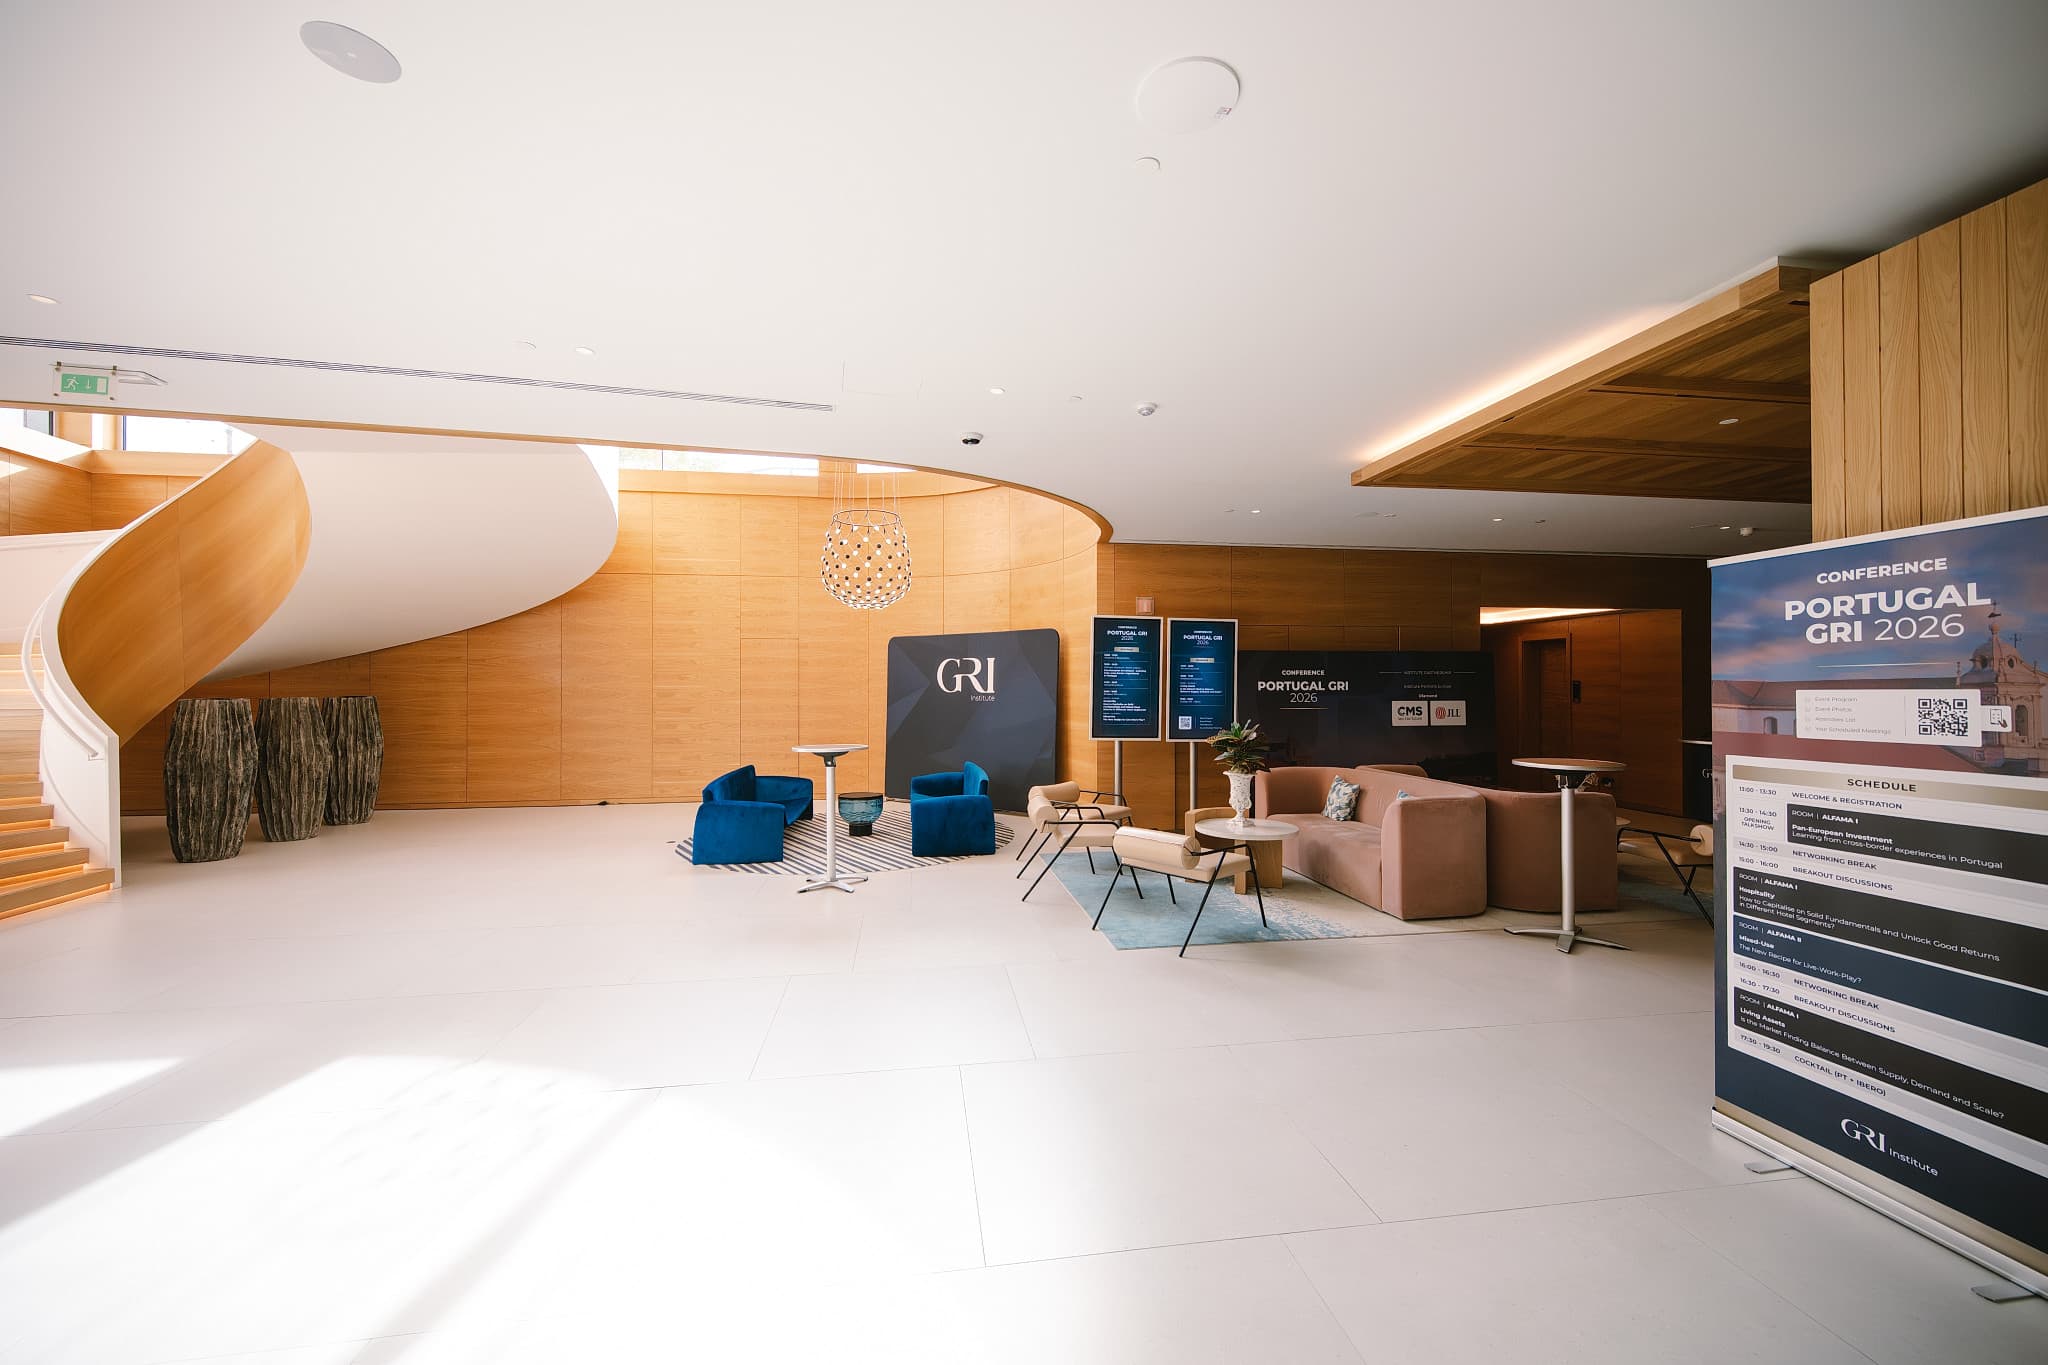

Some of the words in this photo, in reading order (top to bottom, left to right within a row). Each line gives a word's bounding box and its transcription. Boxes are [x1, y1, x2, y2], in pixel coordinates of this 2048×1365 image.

[1817, 558, 1947, 584] CONFERENCE
[1785, 582, 1991, 620] PORTUGAL
[1806, 620, 1862, 644] GRI
[1874, 614, 1964, 640] 2026
[936, 657, 996, 694] GRI
[1258, 681, 1325, 692] PORTUGAL
[1328, 681, 1349, 691] GRI
[1290, 693, 1318, 703] 2026
[1397, 707, 1423, 716] CMS
[1448, 709, 1461, 717] JLL
[1847, 778, 1917, 792] SCHEDULE
[1792, 792, 1830, 802] WELCOME
[1840, 797, 1902, 809] REGISTRATION
[1822, 814, 1854, 824] ALFAMA
[1792, 824, 1843, 837] Pan-European
[1846, 832, 1893, 845] Investment
[1792, 831, 1822, 842] Learning
[1824, 835, 1841, 843] from
[1843, 838, 1892, 852] cross-border
[1895, 847, 1946, 860] experiences
[1960, 856, 2002, 869] Portugal
[1792, 850, 1846, 864] NETWORKING
[1847, 858, 1877, 870] BREAK
[1764, 879, 1794, 889] ALFAMA
[1793, 867, 1833, 879] BREAKOUT
[1835, 875, 1893, 891] DISCUSSIONS
[1740, 886, 1776, 900] Hospitality
[1746, 904, 1775, 915] Different
[1776, 910, 1794, 920] Hotel
[1796, 914, 1835, 929] Segments?
[1740, 895, 1753, 903] How
[1762, 900, 1795, 913] Capitalise
[1807, 910, 1823, 920] Solid
[1826, 915, 1880, 933] Fundamentals
[1882, 929, 1898, 938] and
[1901, 932, 1932, 945] Unlock
[1933, 940, 1958, 952] Good
[1960, 947, 2000, 962] Returns
[1767, 930, 1796, 941] ALFAMA
[1739, 935, 1775, 949] Mixed-Use
[1740, 961, 1756, 971] 16:00
[1752, 947, 1767, 956] New
[1769, 951, 1791, 963] Recipe
[1803, 961, 1862, 983] Live-Work-Play?
[1794, 978, 1848, 1000] NETWORKING
[1850, 996, 1880, 1010] BREAK
[1740, 1008, 1760, 1020] Living
[1762, 1015, 1786, 1028] Assets
[1767, 1004, 1795, 1018] ALFAMA
[1794, 994, 1836, 1012] BREAKOUT
[1838, 1007, 1895, 1033] DISCUSSIONS
[1760, 1023, 1782, 1035] Market
[1784, 1031, 1809, 1046] Finding
[1810, 1041, 1840, 1058] Balance
[1842, 1053, 1876, 1072] Between
[1878, 1067, 1909, 1084] Supply,
[1911, 1079, 1950, 1099] Demand
[1952, 1096, 1970, 1107] and
[1973, 1102, 2005, 1120] Scale?
[1794, 1055, 1833, 1075] COCKTAIL
[1835, 1070, 1848, 1080] (PT
[1856, 1080, 1886, 1096] IBERO)
[1841, 1118, 1885, 1152] GRI
[1890, 1148, 1938, 1176] Institute
